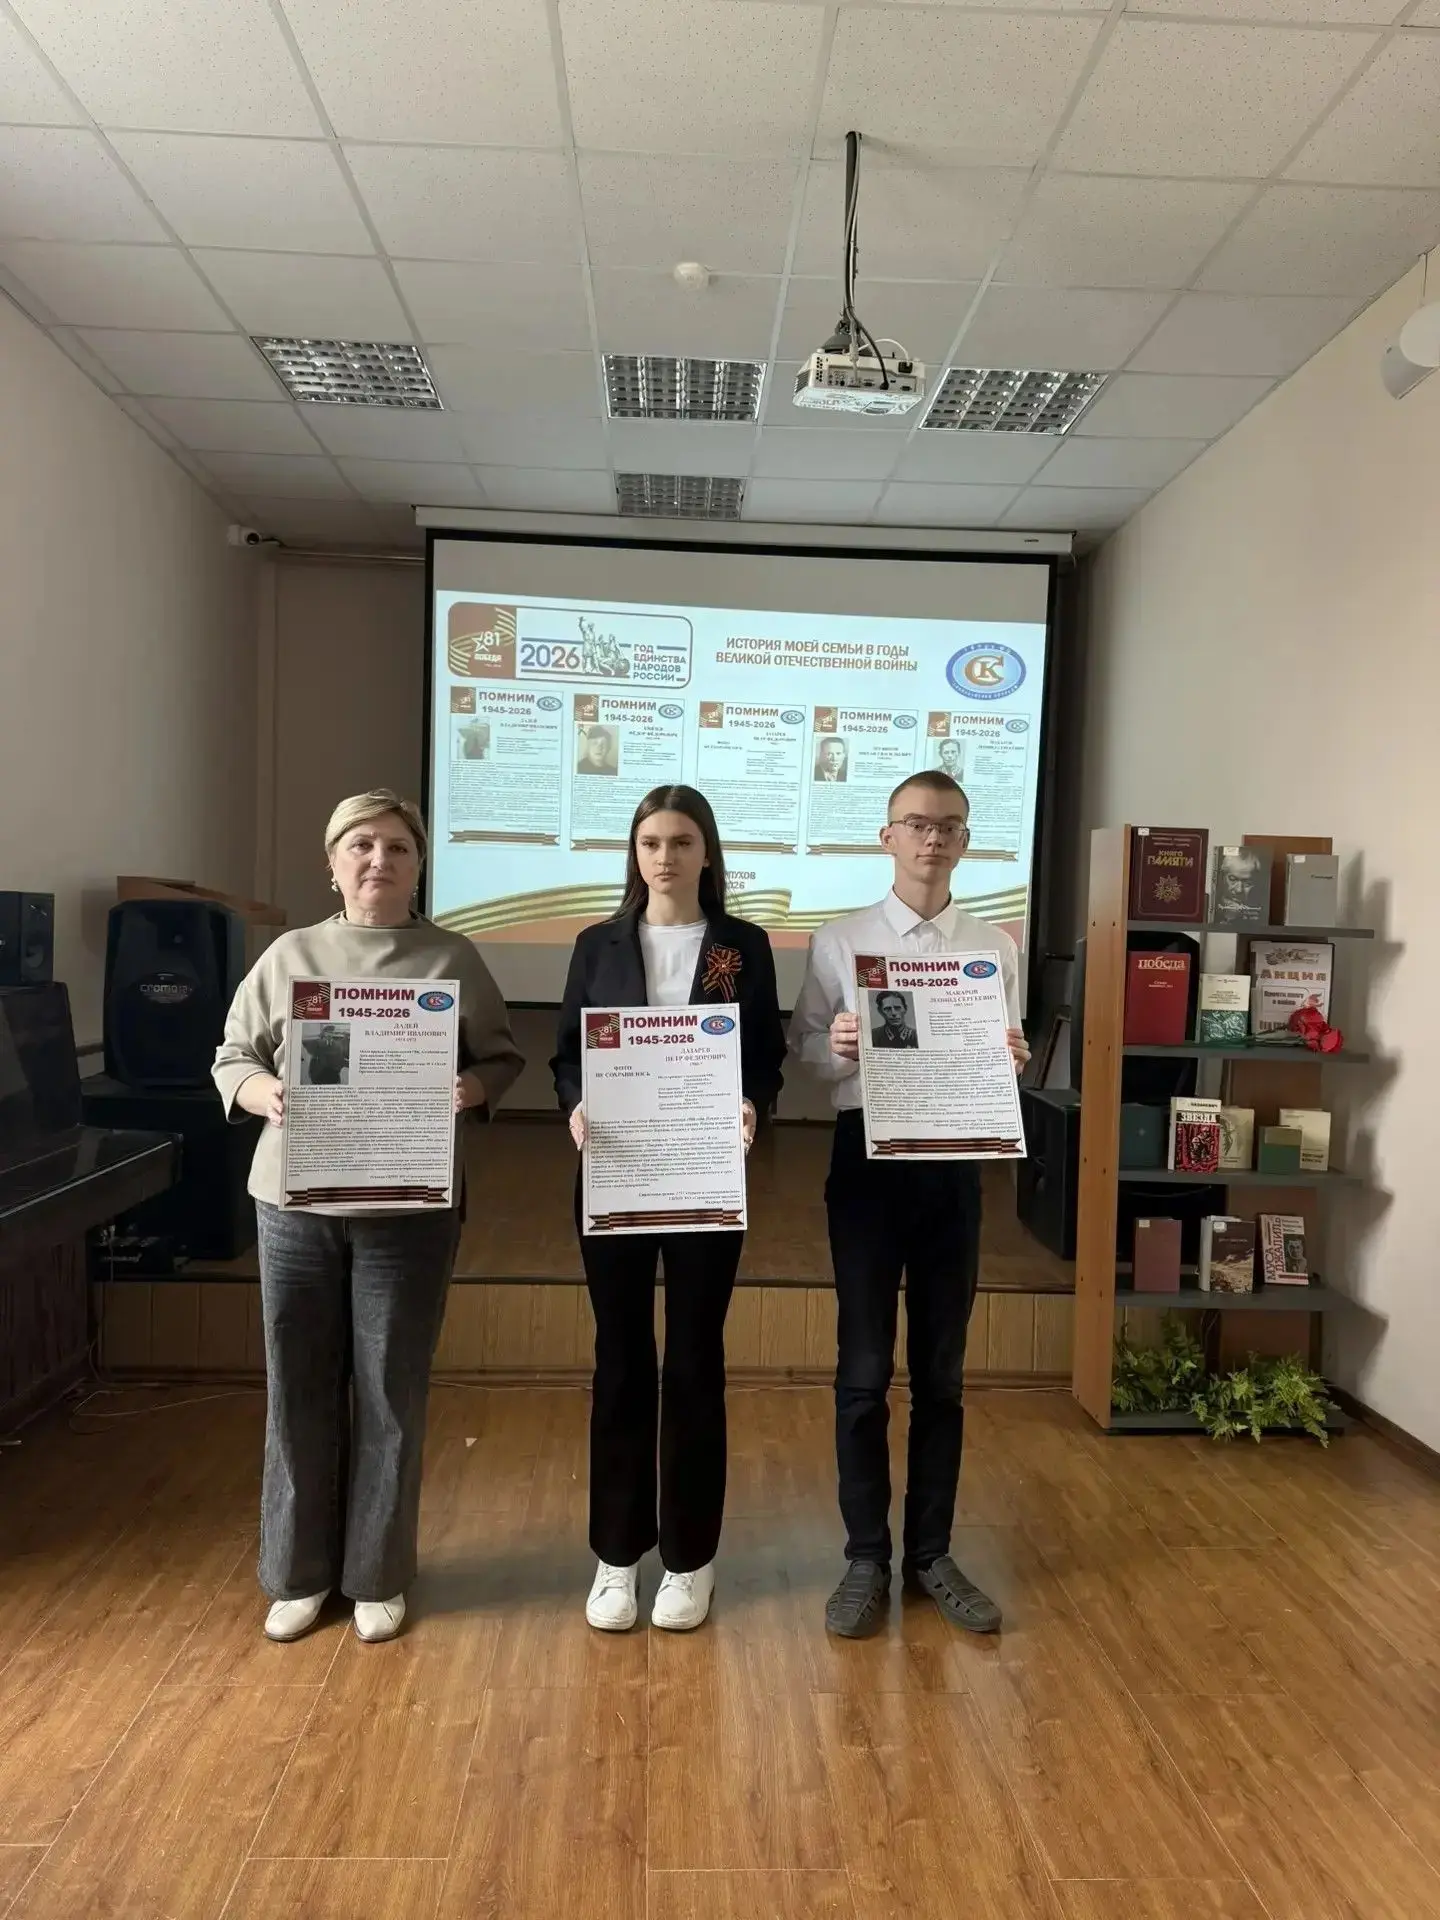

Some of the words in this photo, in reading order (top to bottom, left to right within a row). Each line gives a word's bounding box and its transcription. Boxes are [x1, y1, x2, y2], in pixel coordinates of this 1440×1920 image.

[483, 630, 501, 647] 81
[633, 643, 654, 654] ГОД
[726, 637, 782, 651] ИСТОРИЯ
[784, 639, 819, 653] МОЕЙ
[821, 642, 863, 655] СЕМЬИ
[866, 644, 874, 655] В
[877, 644, 909, 660] ГОДЫ
[520, 643, 581, 669] 2026
[633, 653, 687, 665] ЕДИНСТВА
[716, 651, 771, 665] ВЕЛИКОЙ
[773, 654, 871, 670] ОТЕЧЕСТВЕННОЙ
[874, 659, 918, 672] ВОЙНЫ
[633, 662, 682, 674] НАРОДОВ
[633, 672, 675, 682] РОССИИ
[479, 691, 535, 703] ПОМНИМ
[482, 705, 532, 716] 1945-2026
[601, 699, 657, 711] ПОМНИМ
[726, 706, 779, 717] ПОМНИМ
[840, 711, 892, 722] ПОМНИМ
[604, 713, 654, 723] 1945-2026
[728, 719, 776, 729] 1945-2026
[953, 715, 1004, 726] ПОМНИМ
[842, 724, 889, 734] 1945-2026
[955, 729, 1001, 738] 1945-2026
[889, 960, 960, 972] ПОМНИМ
[895, 977, 959, 988] 1945-2026
[334, 988, 415, 1001] ПОМНИМ
[338, 1007, 411, 1019] 1945-2026
[623, 1015, 698, 1029] ПОМНИМ
[628, 1034, 695, 1046] 1945-2026
